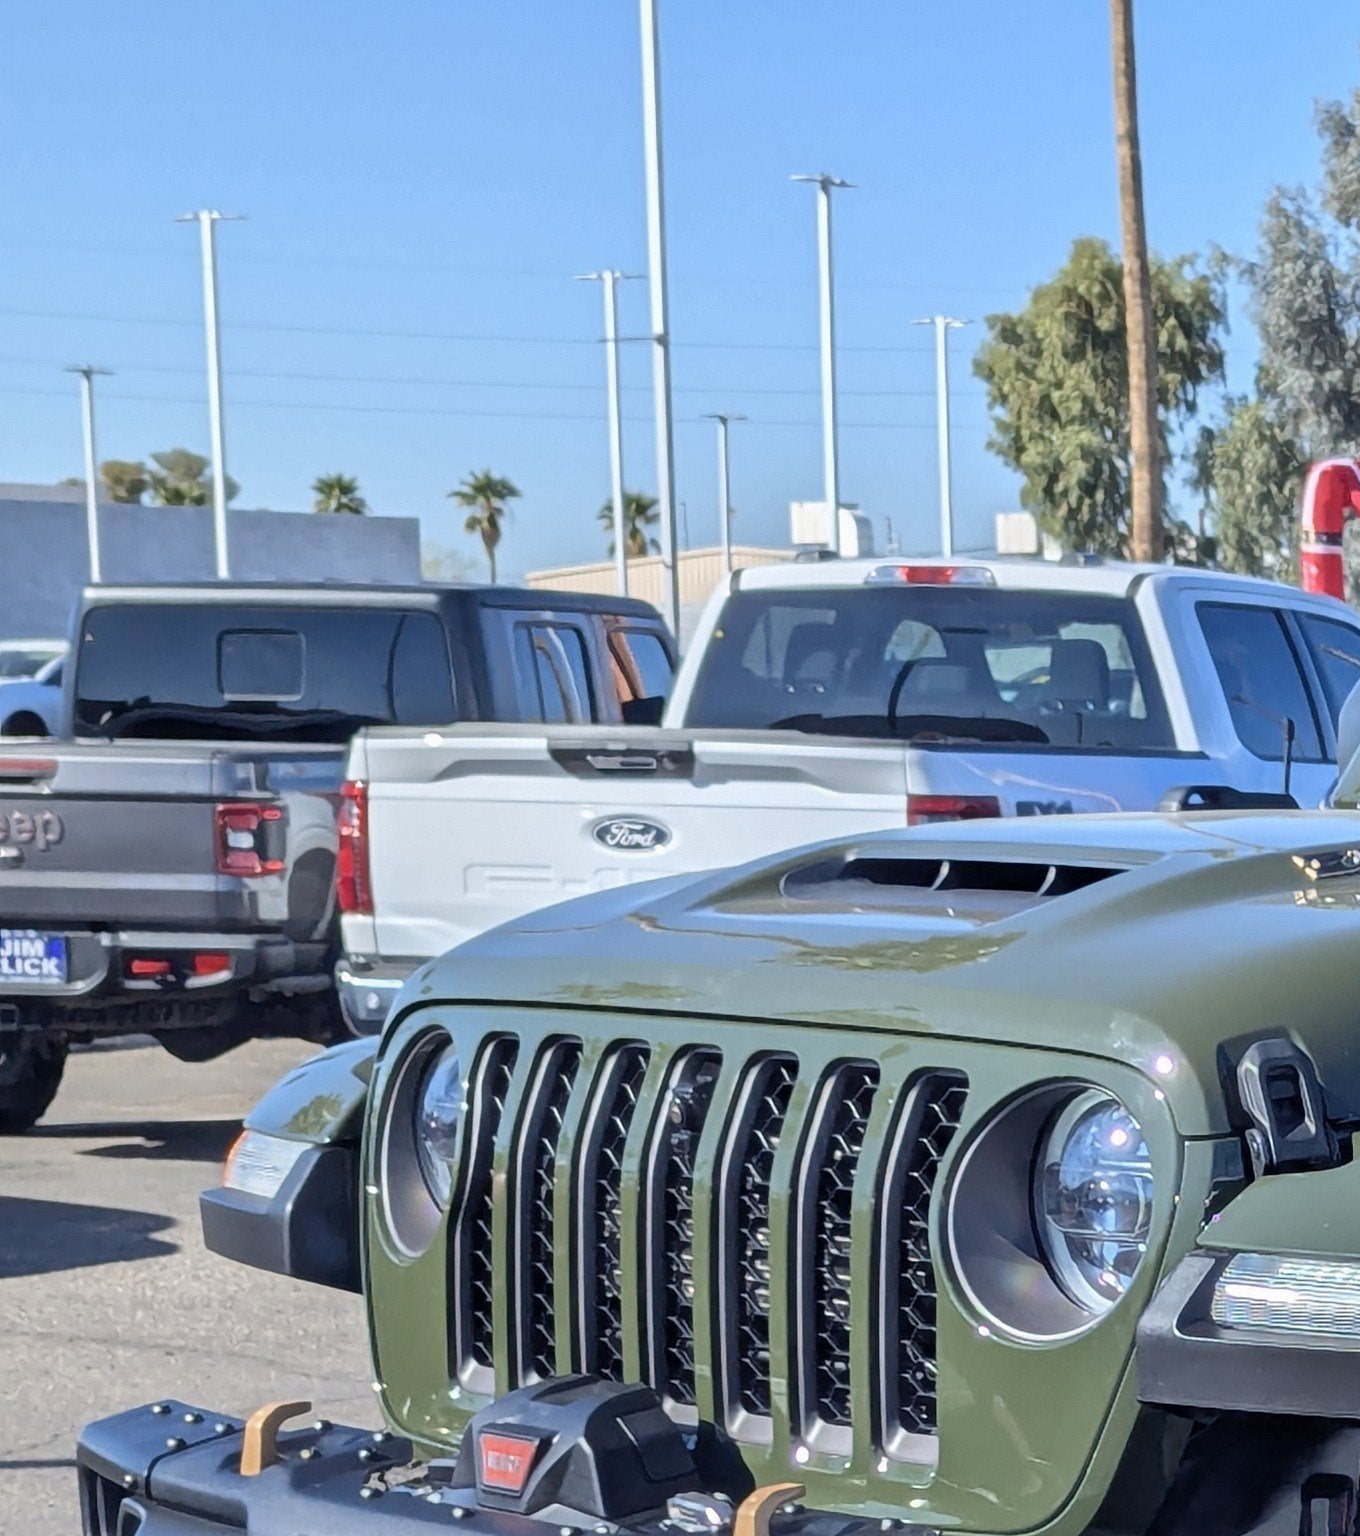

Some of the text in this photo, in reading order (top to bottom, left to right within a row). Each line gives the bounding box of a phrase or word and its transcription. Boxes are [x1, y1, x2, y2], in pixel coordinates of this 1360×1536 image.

[605, 823, 656, 846] Ford
[0, 938, 45, 957] JIM
[0, 956, 60, 977] LICK
